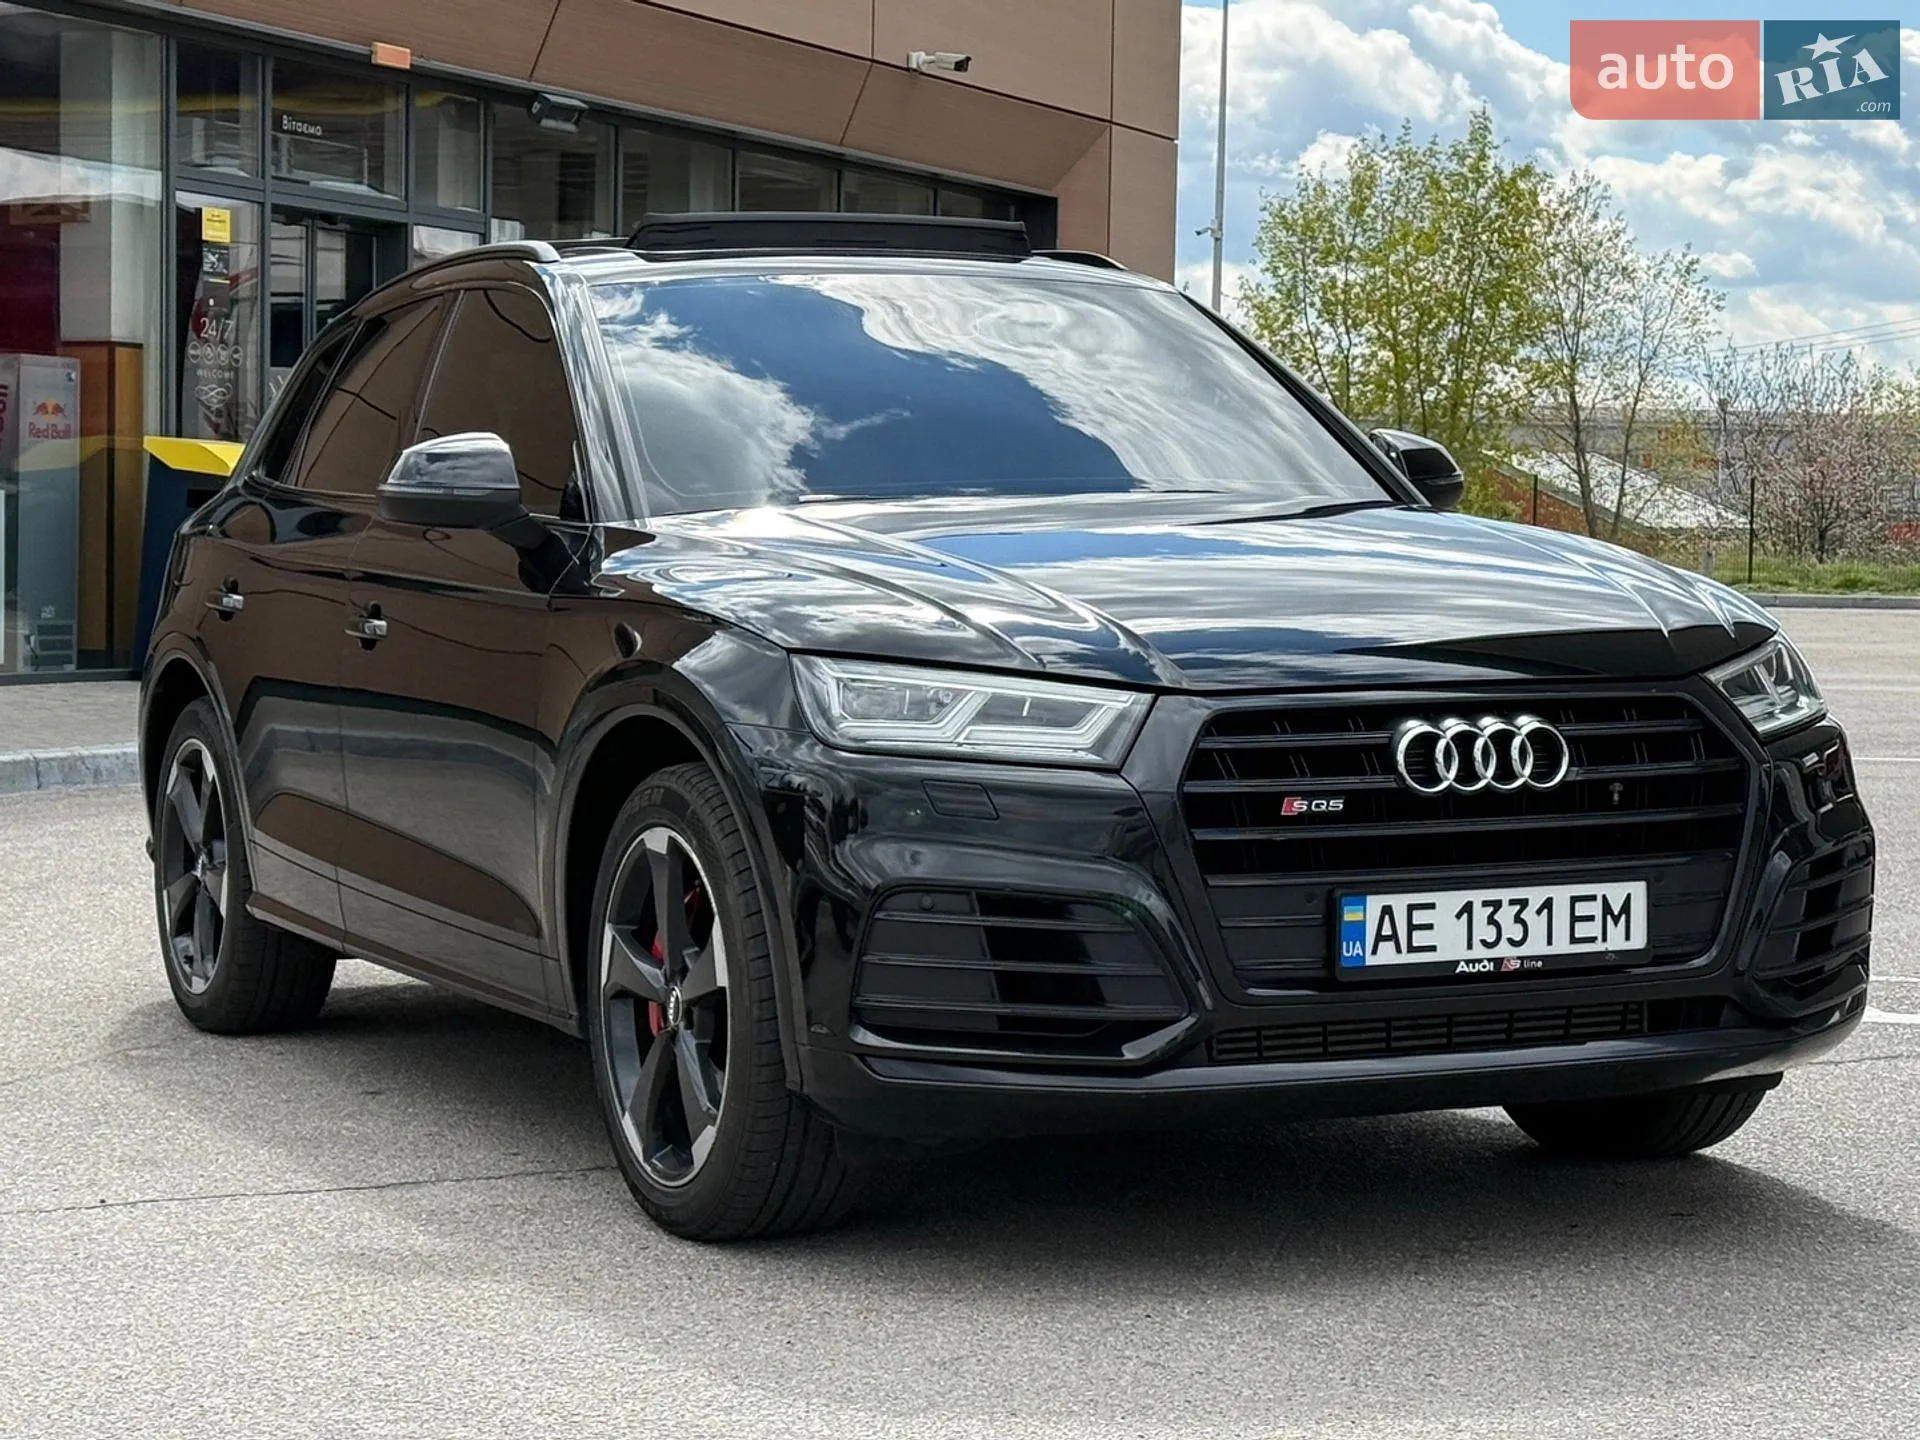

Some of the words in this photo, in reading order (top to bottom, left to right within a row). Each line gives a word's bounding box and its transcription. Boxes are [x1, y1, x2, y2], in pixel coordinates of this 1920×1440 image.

[200, 317, 234, 341] 24/7
[28, 421, 49, 439] Red
[1283, 797, 1345, 814] SQ5
[1370, 902, 1438, 955] AE
[1454, 895, 1554, 950] 1331
[1568, 892, 1632, 945] EM
[1342, 942, 1364, 958] UA
[1455, 958, 1495, 974] Audi
[1523, 959, 1543, 970] line
